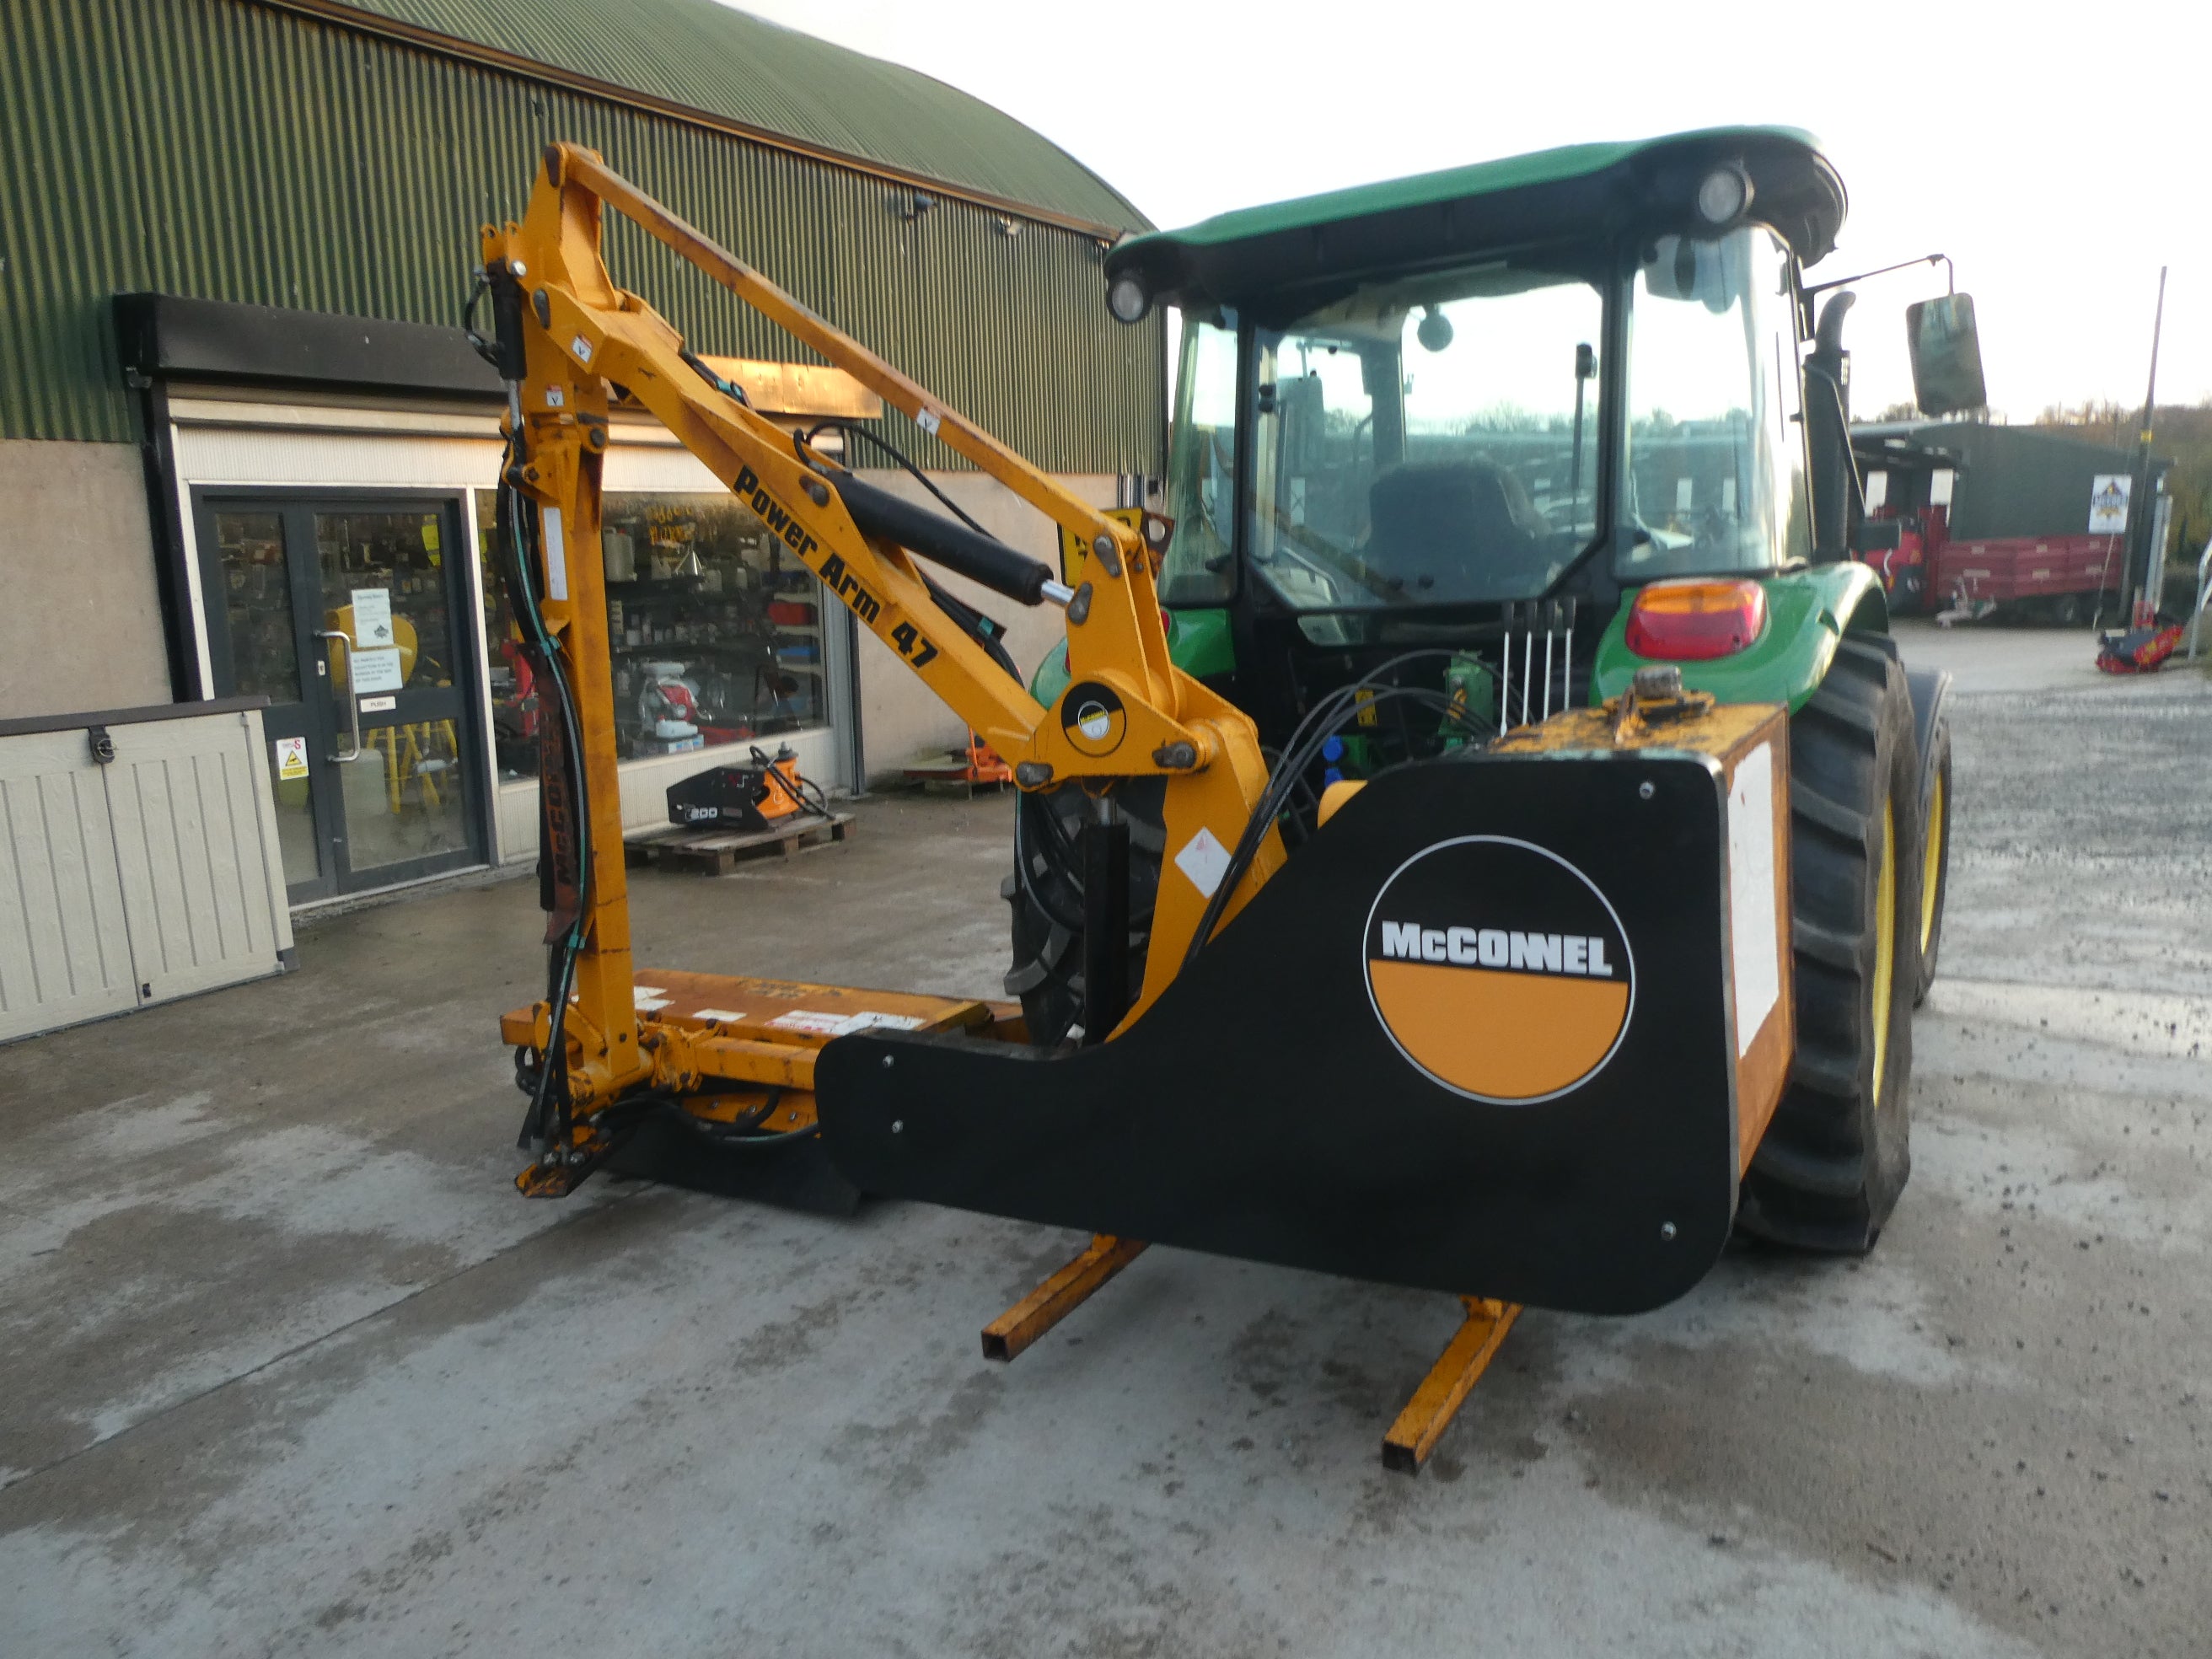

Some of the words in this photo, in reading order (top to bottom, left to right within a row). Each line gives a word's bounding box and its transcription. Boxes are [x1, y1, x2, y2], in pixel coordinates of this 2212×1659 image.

[733, 464, 818, 556] Power
[819, 552, 881, 624] Arm
[891, 620, 938, 668] 47
[1382, 921, 1613, 976] McCONNEL
